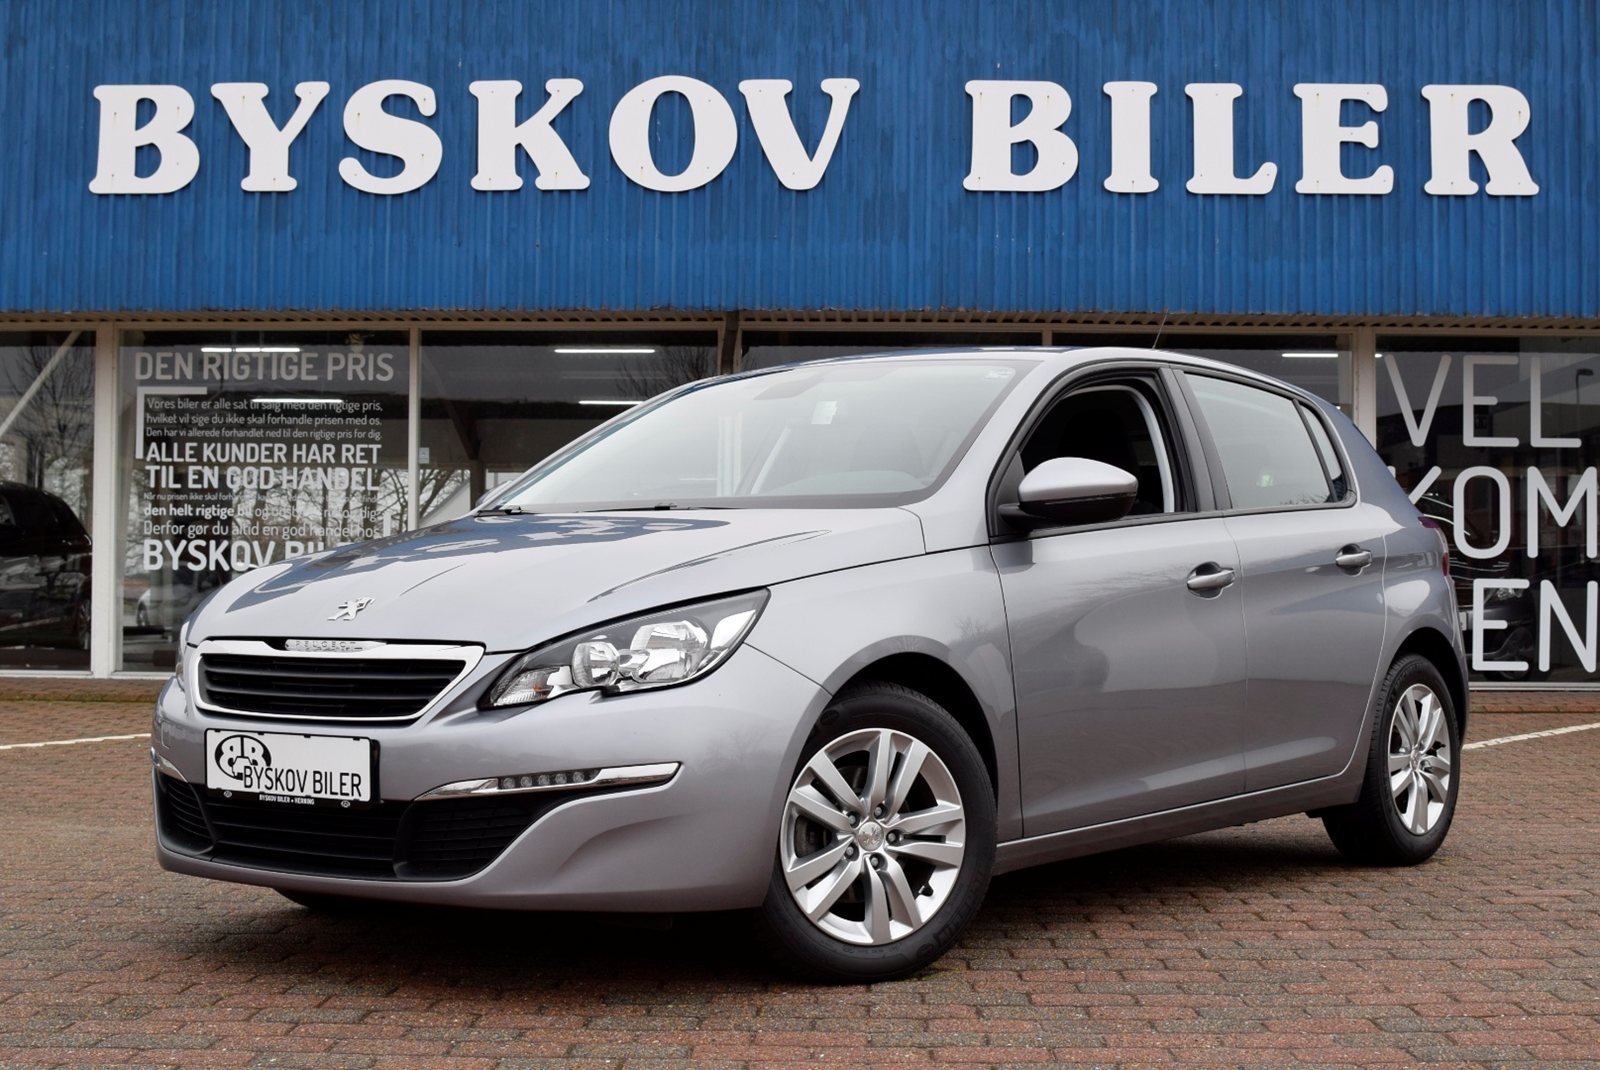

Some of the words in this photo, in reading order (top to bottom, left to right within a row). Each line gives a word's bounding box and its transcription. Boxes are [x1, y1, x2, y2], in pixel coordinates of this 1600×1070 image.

[88, 75, 860, 194] BYSKOV
[963, 79, 1540, 196] BILER
[134, 352, 193, 381] DEN
[202, 352, 319, 381] RIGTIGE
[327, 352, 394, 381] PRIS
[147, 398, 175, 410] Vores
[178, 398, 198, 410] biler
[201, 401, 212, 410] er
[213, 398, 231, 410] alle
[233, 400, 248, 411] sat
[249, 399, 260, 411] til
[261, 399, 281, 413] salg
[283, 399, 305, 411] med
[308, 399, 327, 411] den
[329, 399, 360, 413] rigtige
[1383, 354, 1582, 448] VEL
[146, 413, 177, 424] hvilket
[179, 413, 190, 424] vil
[191, 414, 210, 427] sige
[211, 413, 224, 424] du
[226, 414, 245, 424] ikke
[247, 414, 266, 425] skal
[267, 414, 313, 425] forhandle
[314, 415, 343, 427] prisen
[346, 415, 367, 425] med
[146, 427, 162, 437] Den
[164, 427, 177, 437] har
[178, 428, 187, 437] vi
[187, 428, 220, 437] allerede
[221, 428, 264, 437] forhandlet
[265, 429, 281, 438] ned
[283, 429, 291, 438] til
[292, 429, 308, 438] den
[310, 429, 336, 440] rigtige
[337, 430, 352, 440] pris
[354, 430, 366, 438] for
[146, 442, 198, 462] ALLE
[203, 443, 287, 463] KUNDER
[293, 443, 336, 464] HAR
[341, 444, 382, 465] RET
[145, 465, 182, 489] TIL
[188, 465, 219, 489] EN
[226, 466, 275, 490] GOD
[281, 466, 380, 491] HANDEL
[144, 502, 166, 516] den
[169, 503, 193, 516] helt
[195, 504, 235, 520] rigtige
[255, 508, 269, 520] og
[144, 520, 185, 535] Derfor
[187, 524, 209, 539] gør
[212, 520, 229, 535] du
[231, 521, 260, 536] altid
[262, 525, 279, 536] en
[282, 522, 304, 540] god
[143, 539, 275, 572] BYSKOV
[243, 765, 308, 793] BYSKOV
[312, 770, 362, 797] BILER
